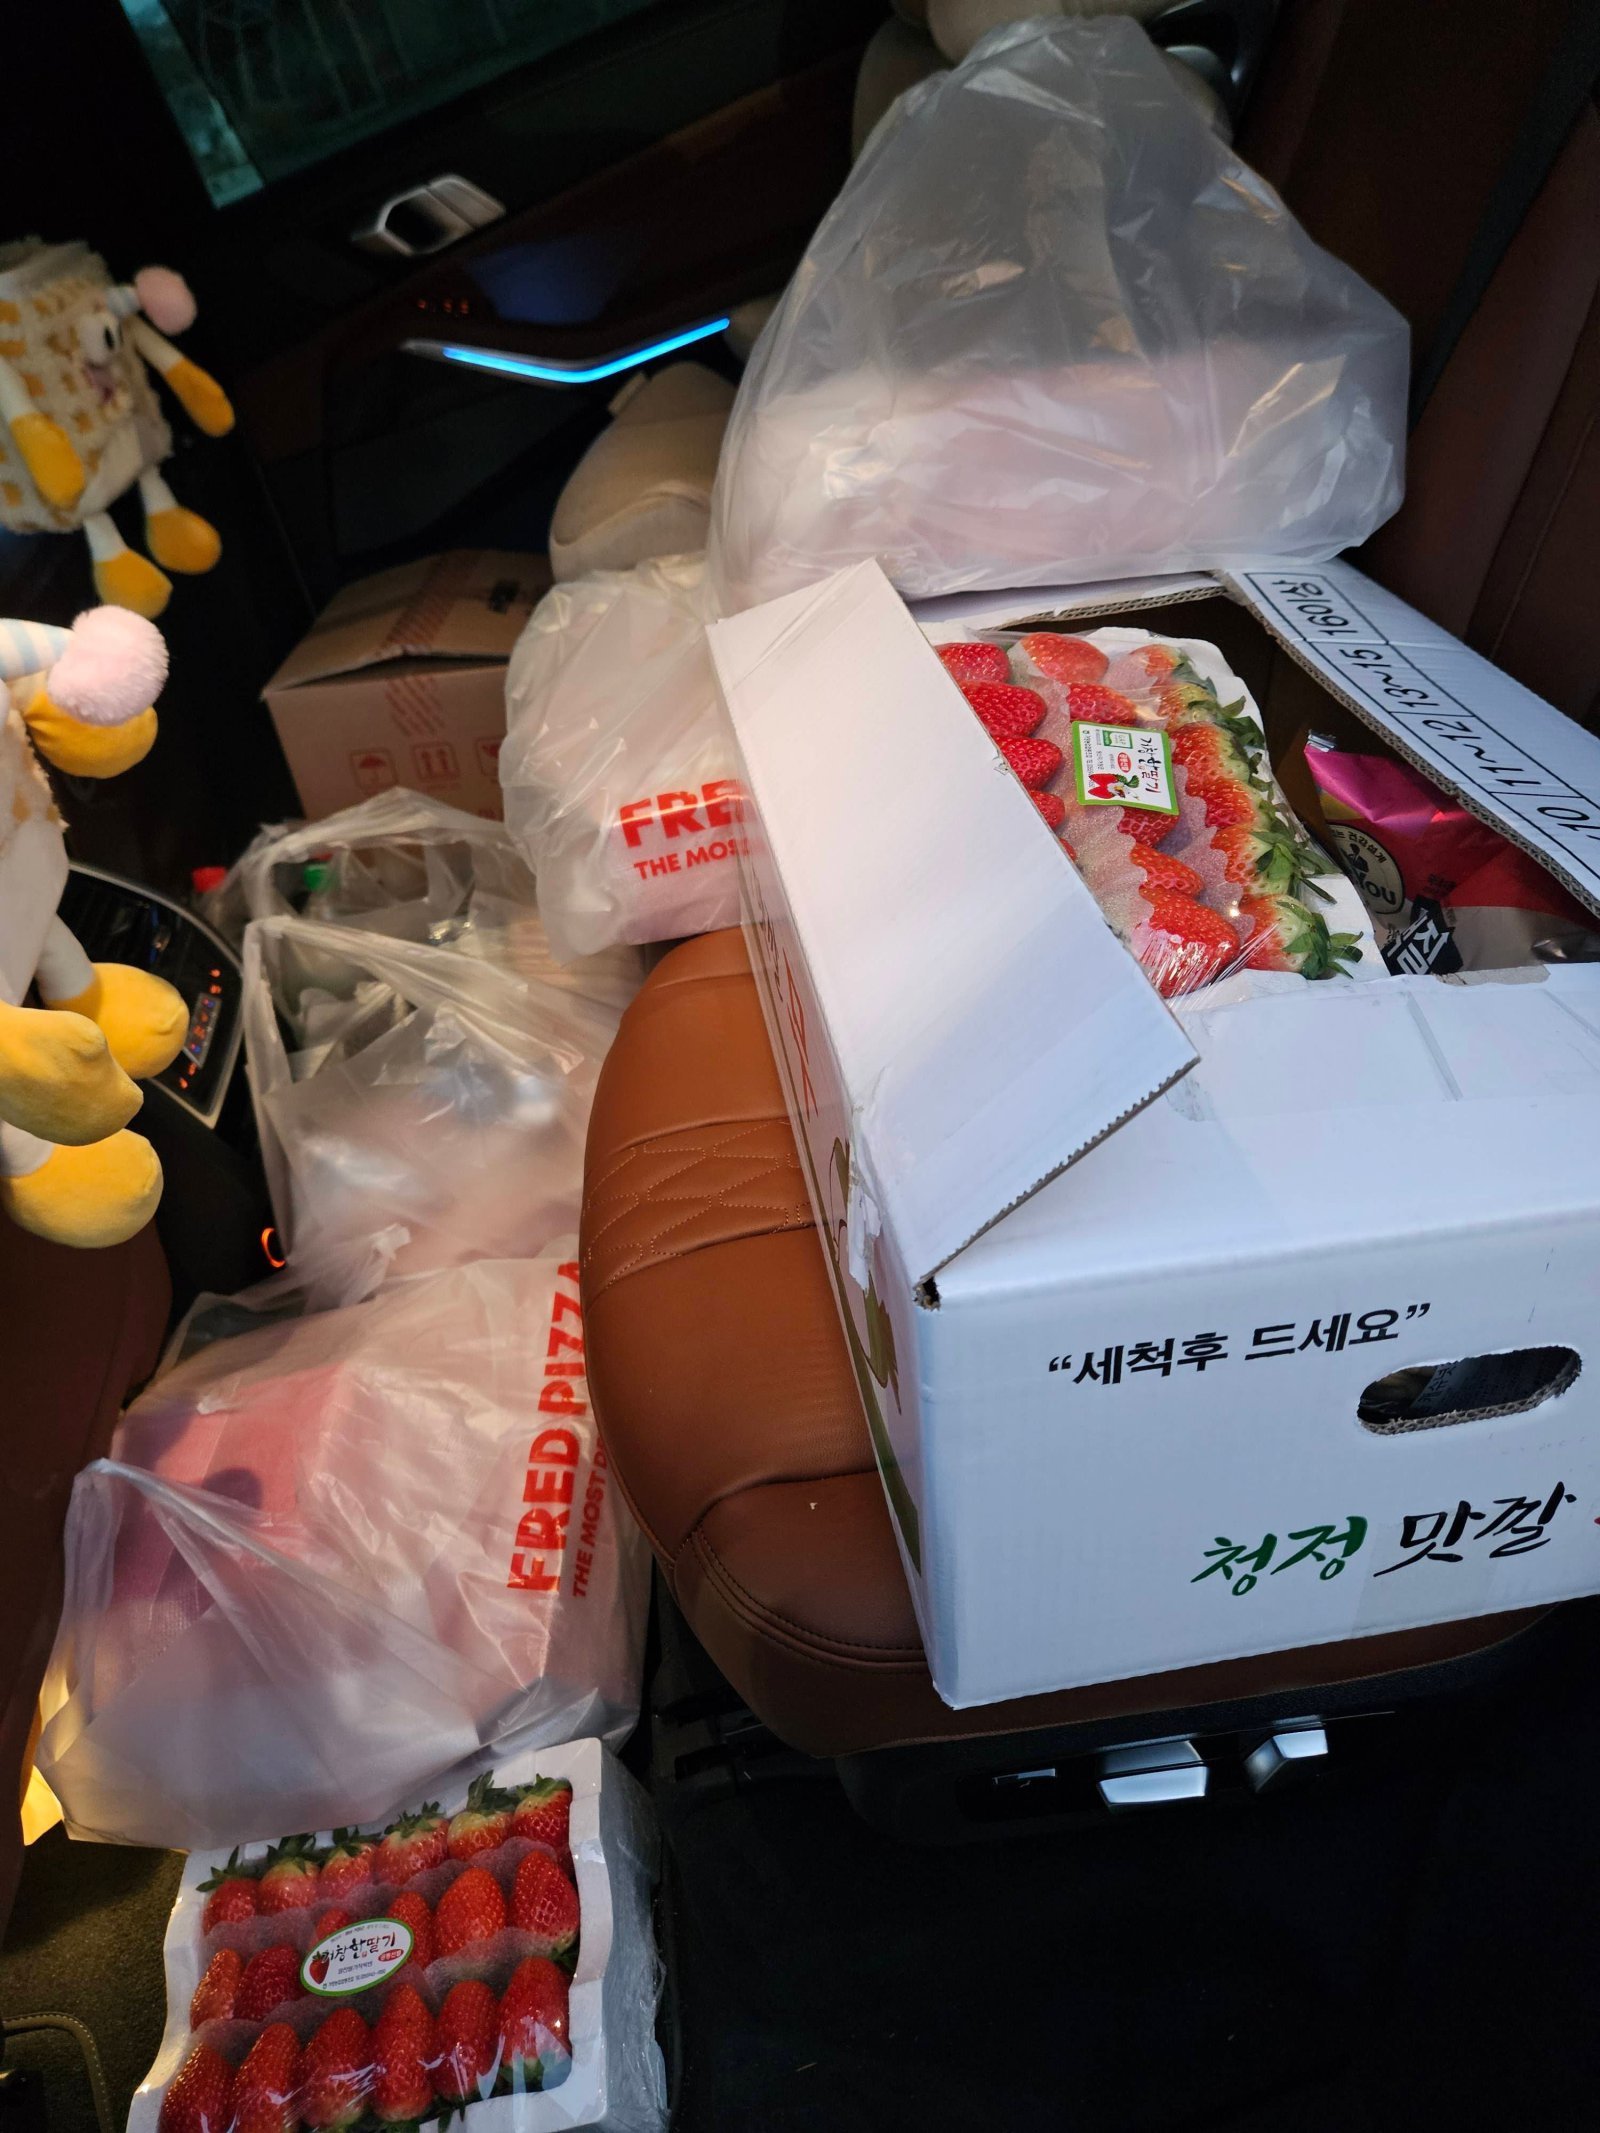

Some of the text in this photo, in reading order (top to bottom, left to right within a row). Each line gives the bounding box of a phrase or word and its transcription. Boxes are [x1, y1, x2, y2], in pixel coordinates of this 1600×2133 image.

[1338, 649, 1440, 708] 13~15
[619, 779, 740, 848] FRE
[633, 838, 737, 881] THE MOS
[506, 1427, 581, 1592] FRED
[580, 1468, 607, 1548] MOST
[1190, 1481, 1578, 1597] 청정 맛깔
[572, 1548, 595, 1598] THE
